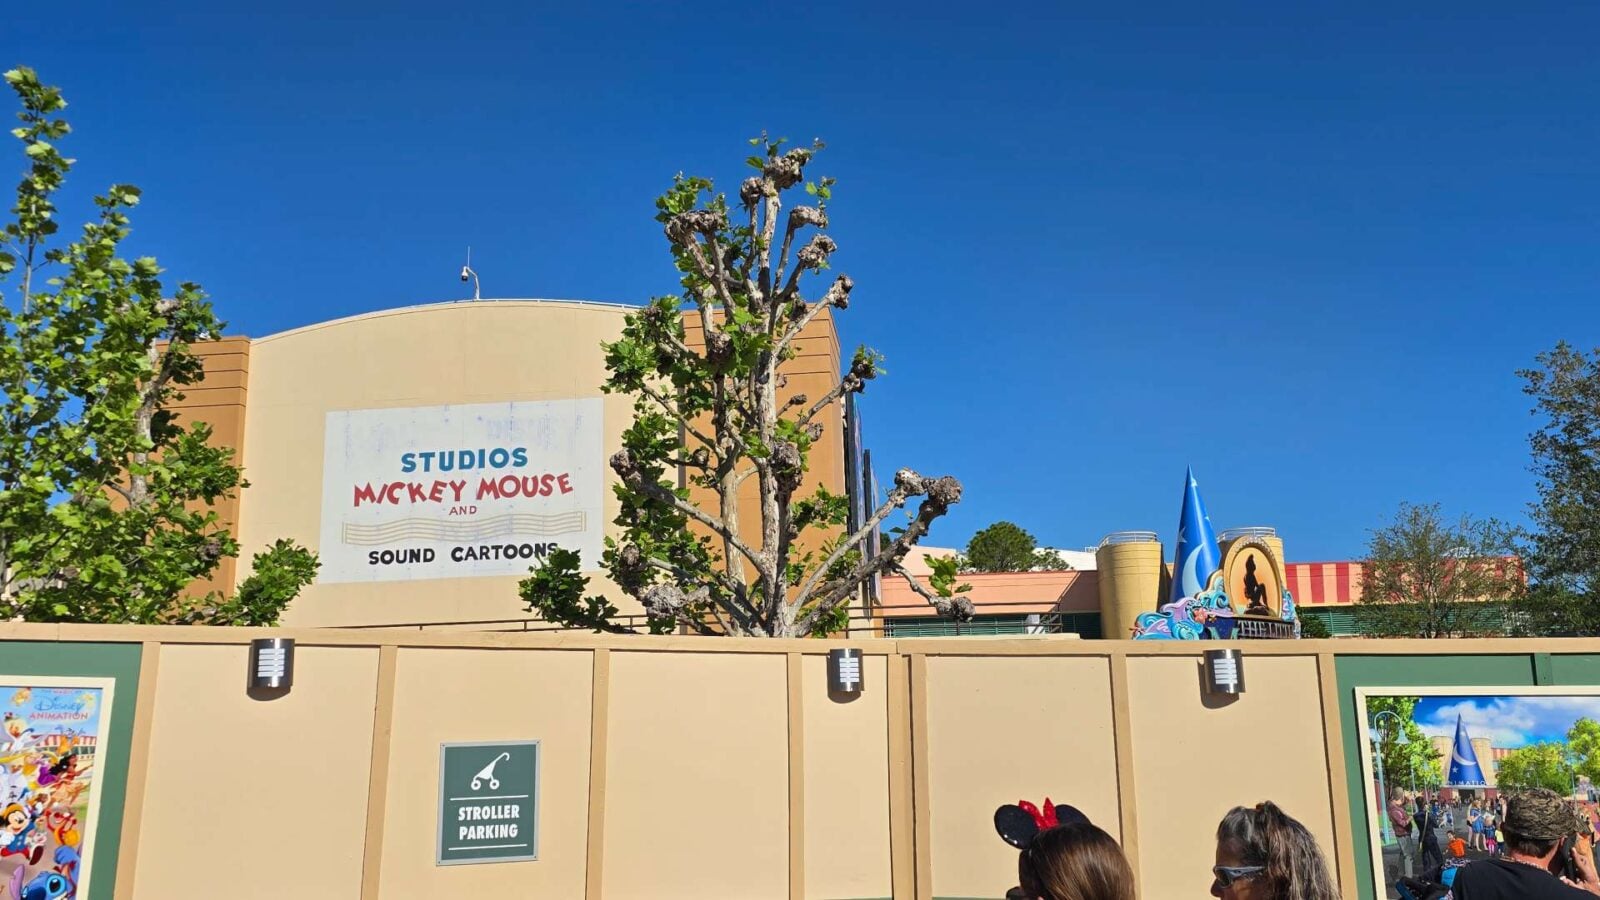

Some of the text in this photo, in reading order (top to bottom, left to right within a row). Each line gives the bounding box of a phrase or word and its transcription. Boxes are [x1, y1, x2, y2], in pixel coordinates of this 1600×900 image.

[401, 447, 528, 473] STUDIOS
[353, 473, 573, 507] MICKEY MOUSE
[448, 505, 478, 516] AND
[368, 548, 435, 565] SOUND
[1238, 620, 1267, 638] THE
[458, 805, 519, 820] STROLLER
[459, 824, 518, 840] PARKING
